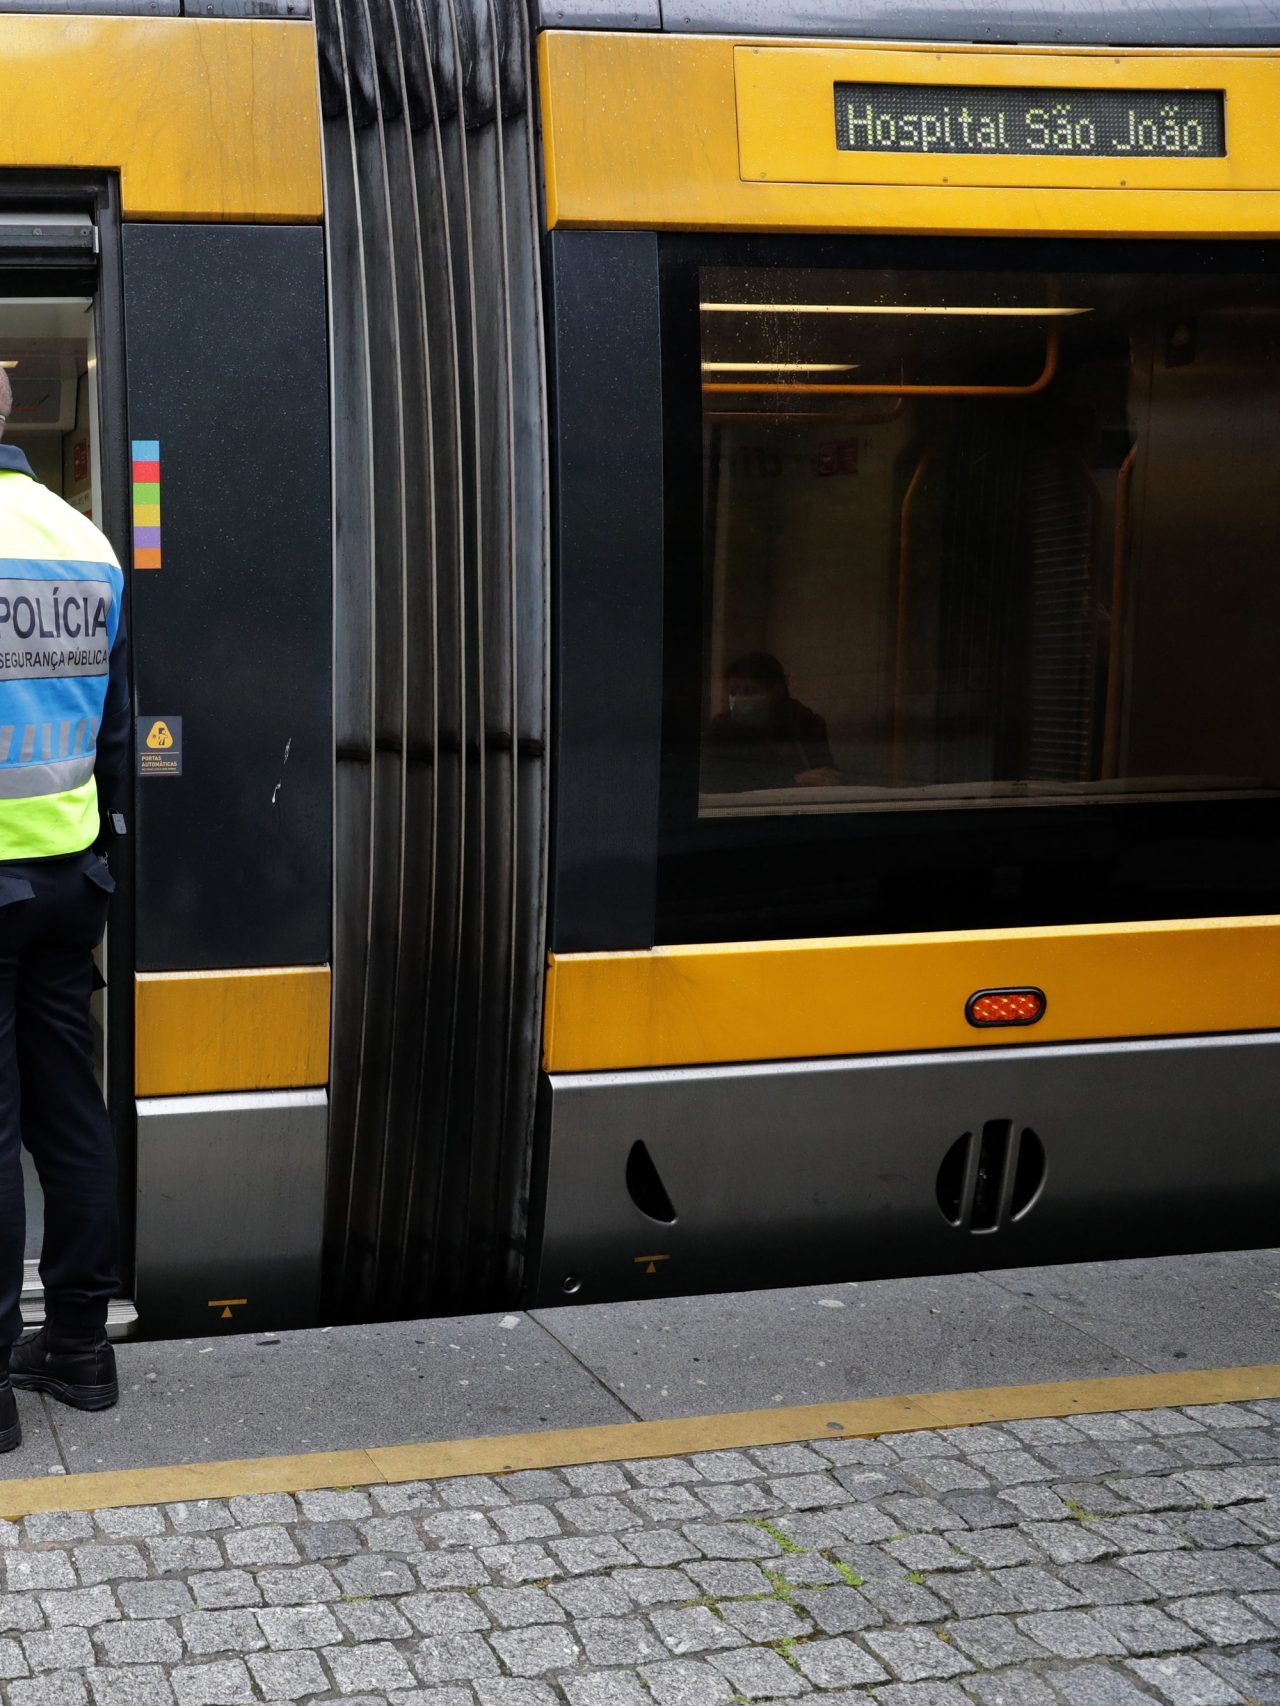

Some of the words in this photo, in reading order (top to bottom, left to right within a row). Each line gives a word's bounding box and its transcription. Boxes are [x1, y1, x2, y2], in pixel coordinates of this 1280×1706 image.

[847, 104, 1009, 151] Hospital
[1025, 104, 1096, 150] São
[1112, 104, 1203, 151] João
[67, 647, 107, 666] PÚBLICA
